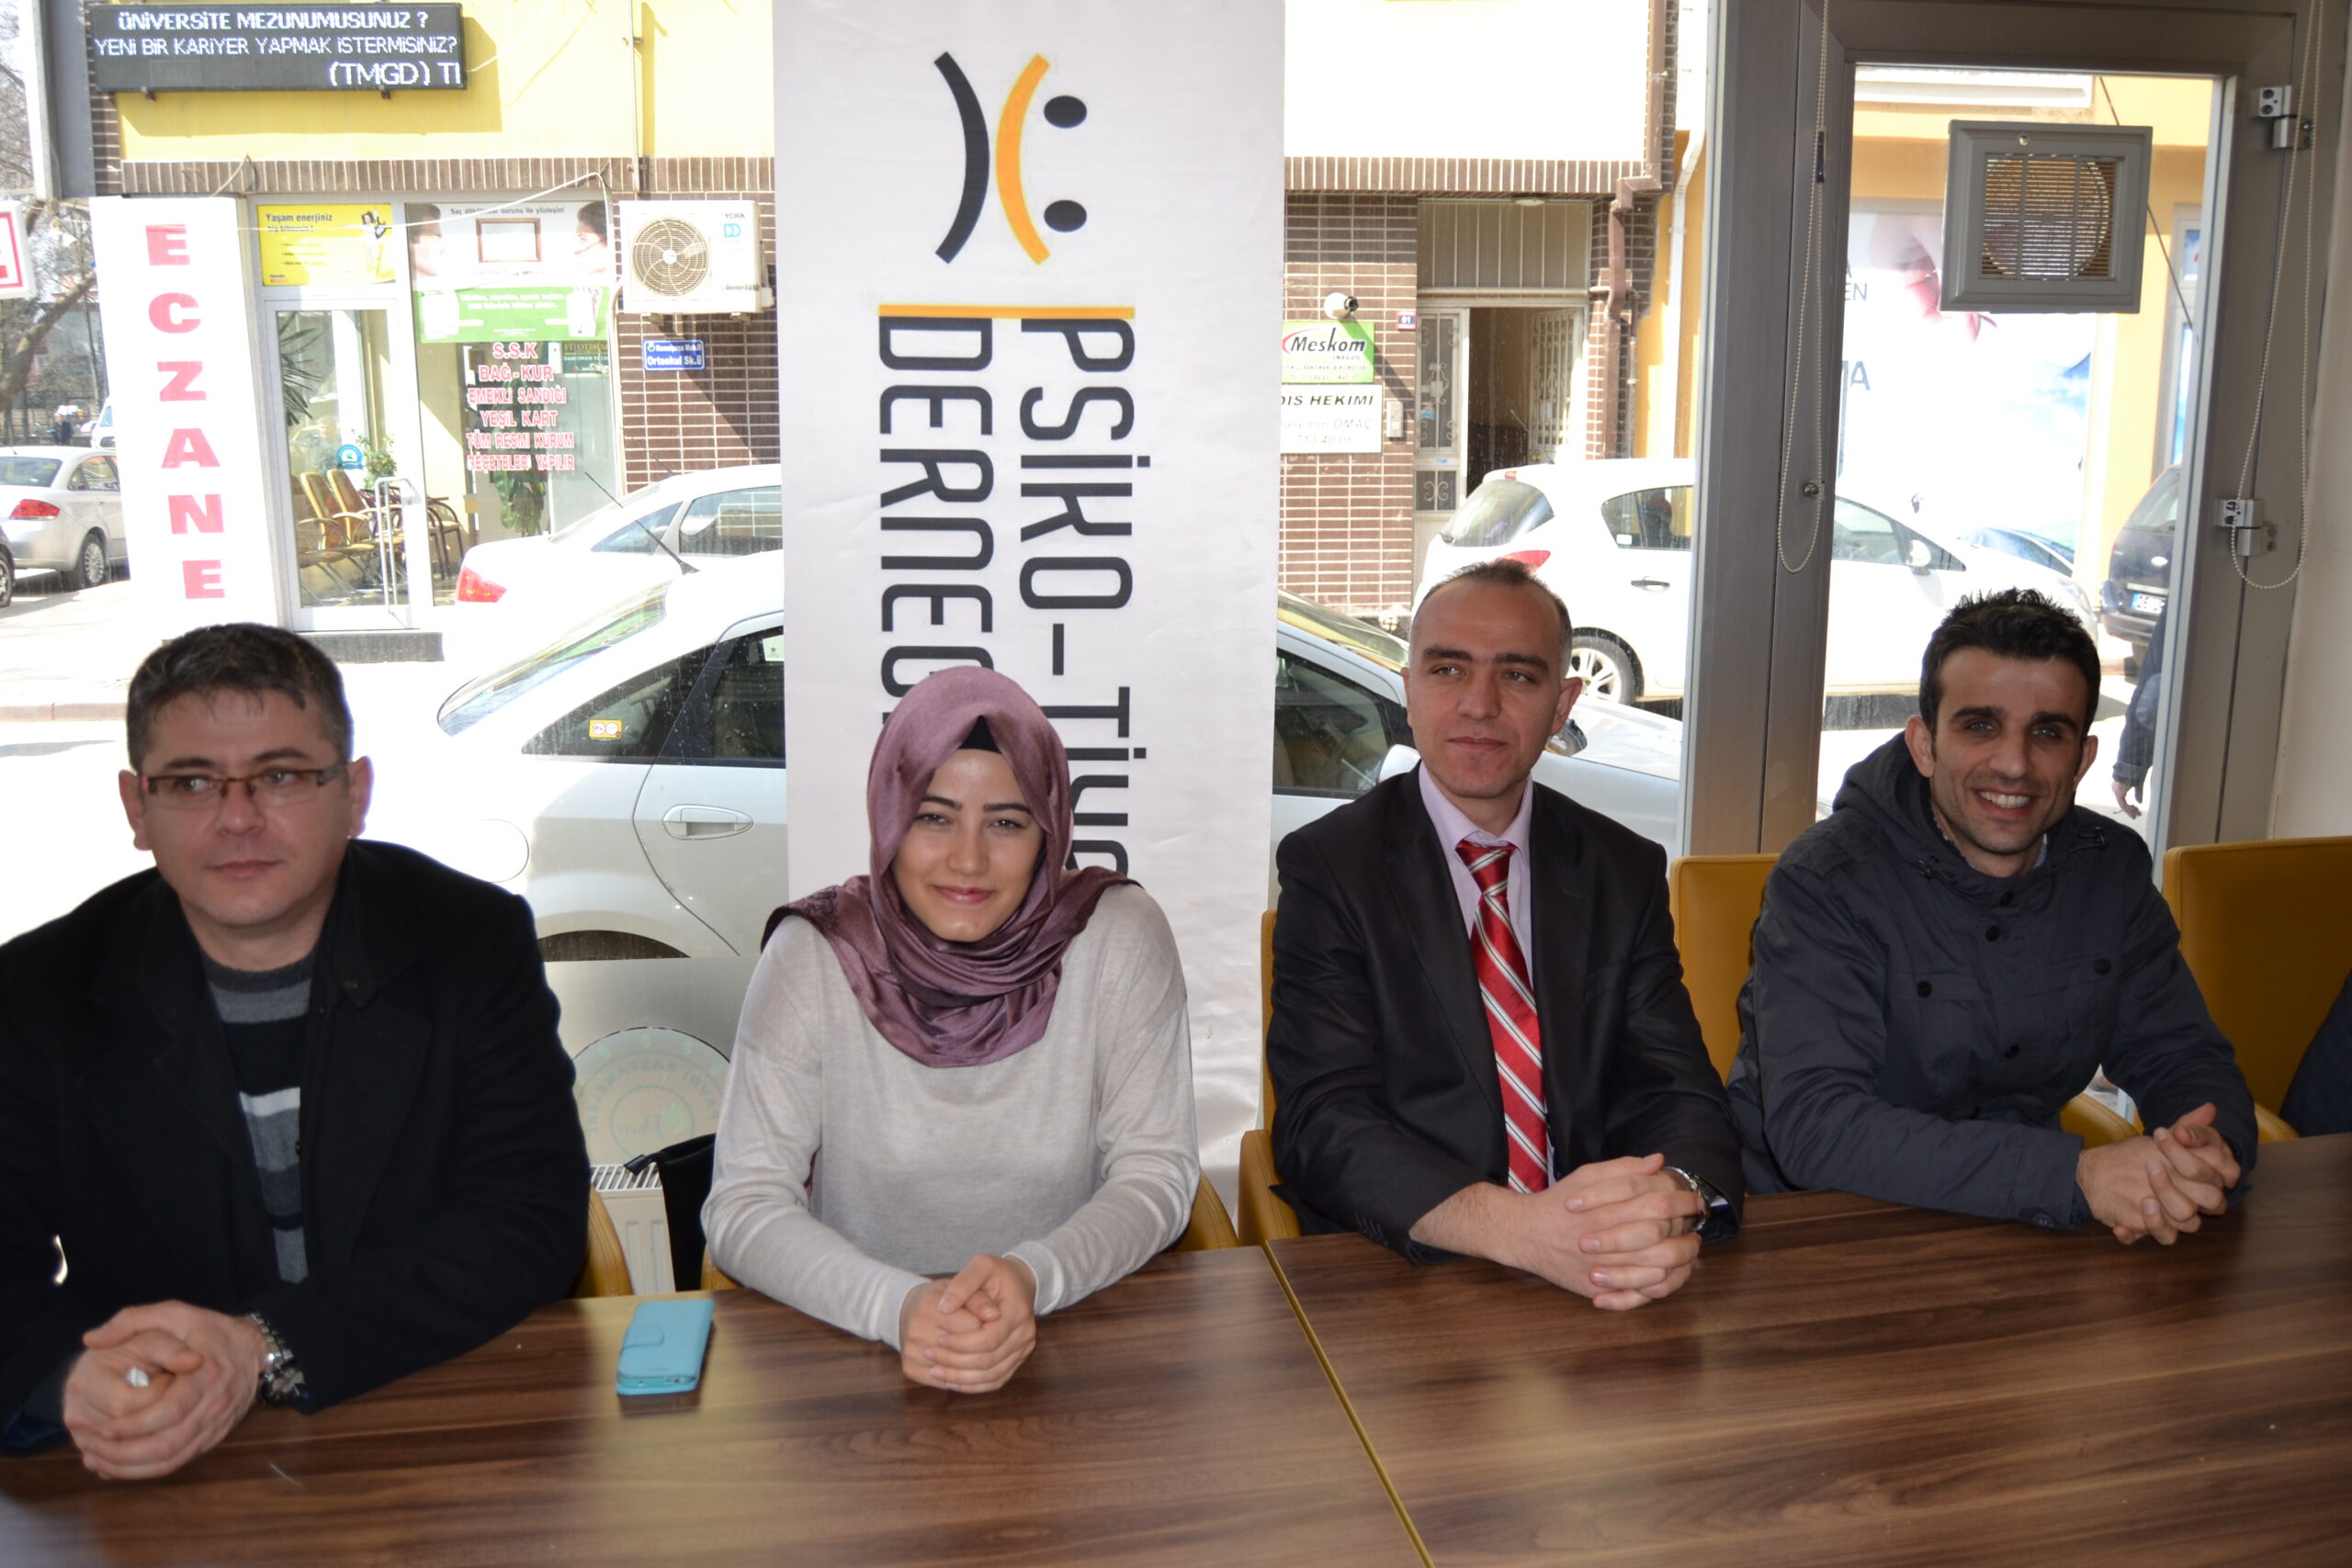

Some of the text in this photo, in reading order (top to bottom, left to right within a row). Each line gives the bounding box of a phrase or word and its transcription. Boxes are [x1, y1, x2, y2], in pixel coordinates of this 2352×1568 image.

[119, 11, 428, 30] ÜNİVERSİTE MEZUNUMUSUNUZ ?
[95, 36, 458, 56] YENİ BİR KARİYER YAPMAK İSTERMİSİNİZ?
[266, 213, 333, 223] Yaşam enerjiniz
[1290, 327, 1365, 352] Meskom
[647, 355, 683, 366] Ortaokul
[145, 223, 226, 599] ECZANE
[521, 410, 559, 427] KART
[466, 429, 492, 448] TÜM
[534, 432, 575, 448] KURUM
[878, 316, 994, 724] DERNE
